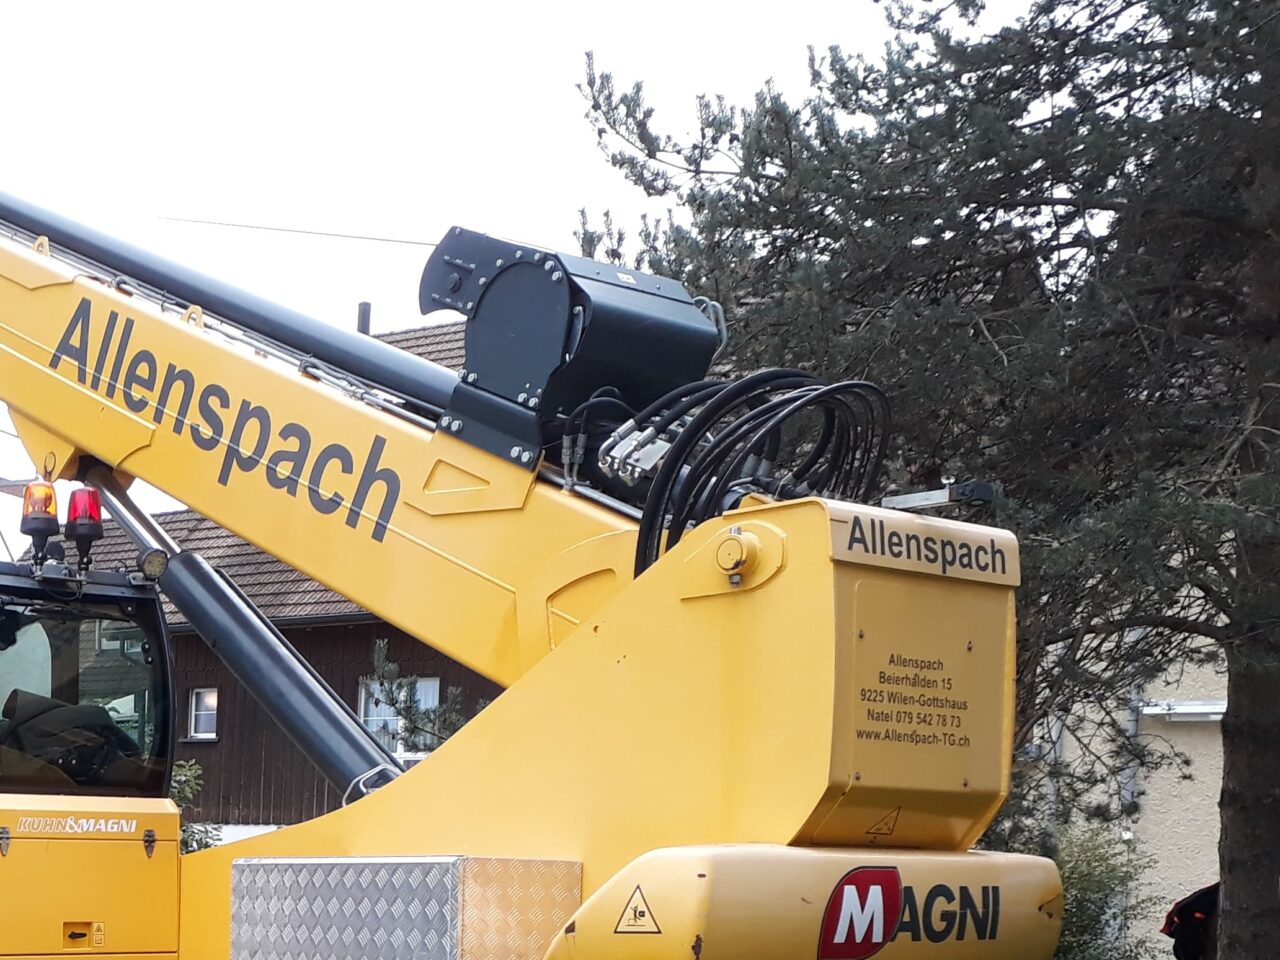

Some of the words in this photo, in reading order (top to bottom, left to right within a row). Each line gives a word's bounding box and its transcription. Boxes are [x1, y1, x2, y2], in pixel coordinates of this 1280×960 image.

[48, 297, 401, 544] Allenspach
[848, 515, 1007, 575] Allenspach
[888, 653, 944, 671] Allenspach
[941, 677, 953, 691] 15
[860, 688, 885, 704] 9225
[887, 690, 968, 711] Wilen-Gottshaus
[867, 708, 894, 723] Natel
[895, 710, 914, 725] 079
[916, 712, 933, 727] 542
[936, 713, 948, 728] 78
[950, 715, 962, 729] 73
[856, 728, 971, 748] www.Allenspach-TG.ch
[832, 883, 1001, 944] MAGNI
